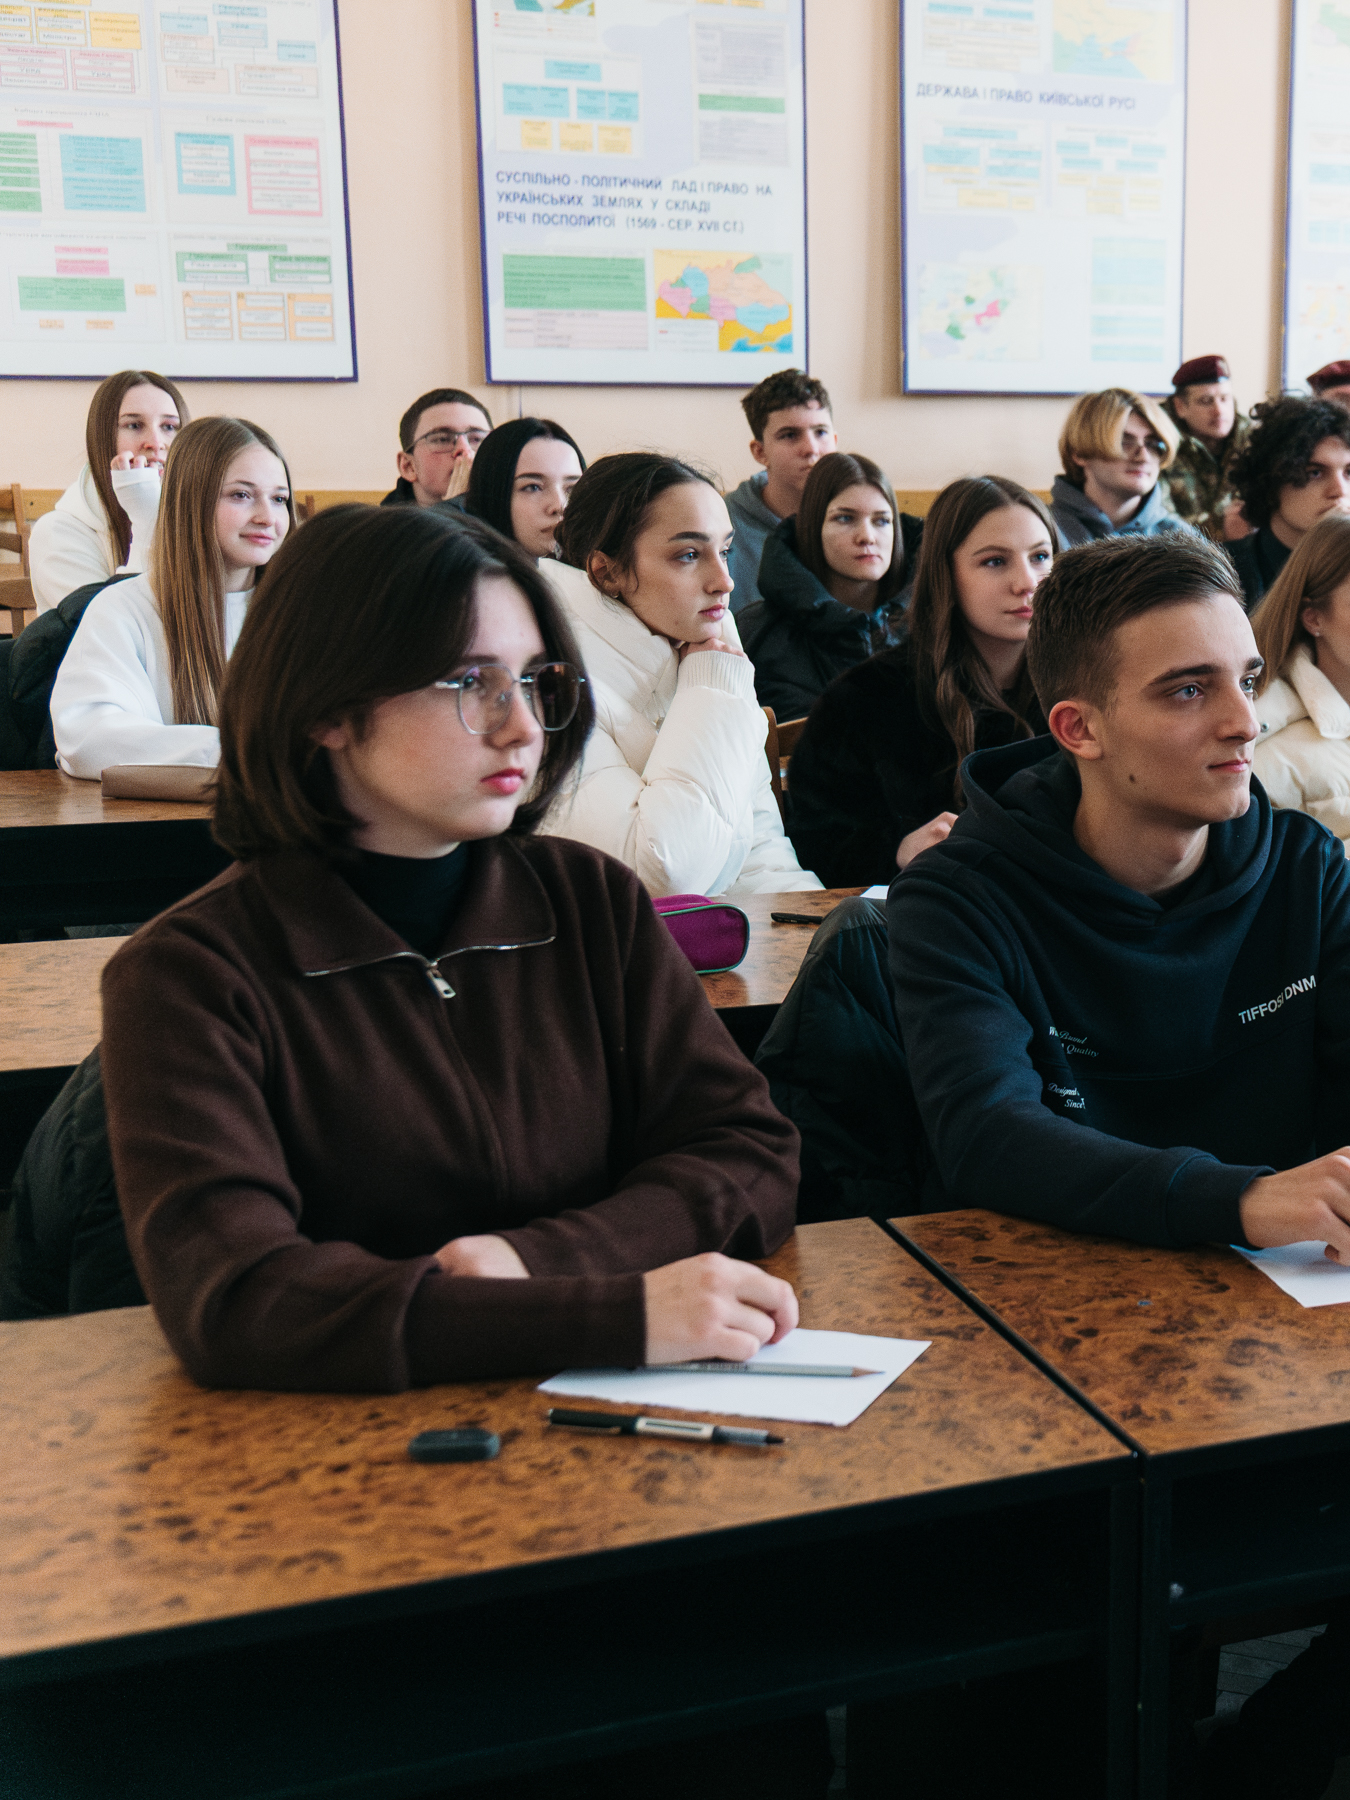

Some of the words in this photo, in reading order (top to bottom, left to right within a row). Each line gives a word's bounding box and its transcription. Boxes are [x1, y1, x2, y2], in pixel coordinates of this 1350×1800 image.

[916, 83, 979, 99] ДЕРЖАВА
[990, 87, 1033, 104] ПРАВО
[1039, 90, 1104, 108] КИЇВСЬКОЇ
[1108, 95, 1136, 110] РУСІ
[496, 170, 571, 186] СУСПІЛЬНО
[581, 174, 662, 190] ПОЛІТИЧНИЙ
[672, 179, 698, 194] ЛАД
[707, 181, 749, 195] ПРАВО
[756, 184, 773, 196] НА
[497, 189, 583, 206] УКРАЇНСЬКИХ
[592, 194, 643, 209] ЗЕМЛЯХ
[651, 198, 659, 210] У
[665, 198, 711, 214] СКЛАДІ
[497, 210, 526, 224] РЕЧІ
[532, 211, 616, 228] ПОСПОЛИТОЇ
[626, 216, 657, 230] (1569
[1238, 992, 1284, 1024] TIFFOSI
[1284, 975, 1316, 1001] DNM
[1066, 1043, 1099, 1058] Quality
